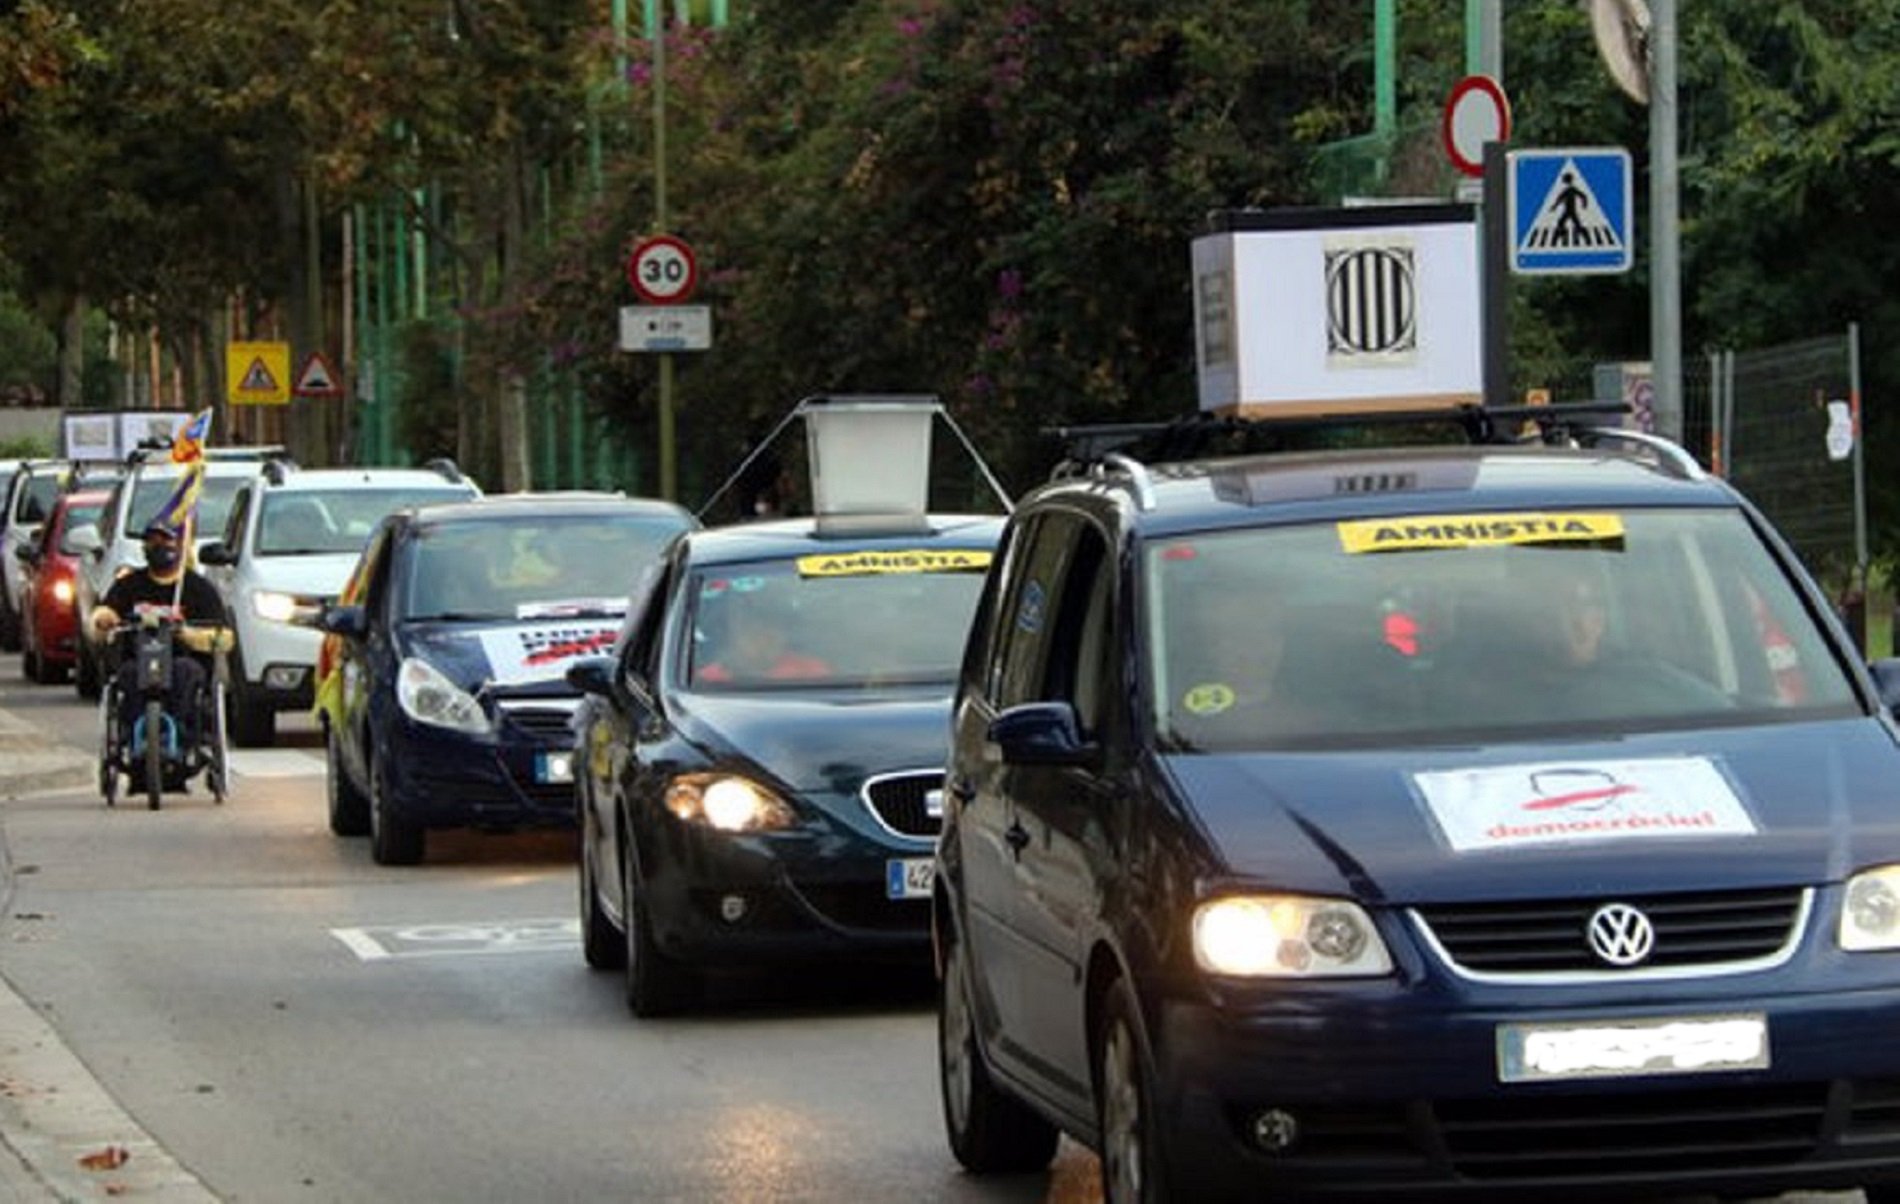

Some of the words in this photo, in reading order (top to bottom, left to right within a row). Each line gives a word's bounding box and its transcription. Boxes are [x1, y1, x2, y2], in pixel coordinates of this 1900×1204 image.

[643, 258, 682, 283] 30
[1374, 519, 1593, 542] AMNISTIA
[821, 555, 971, 571] AMNISTIA
